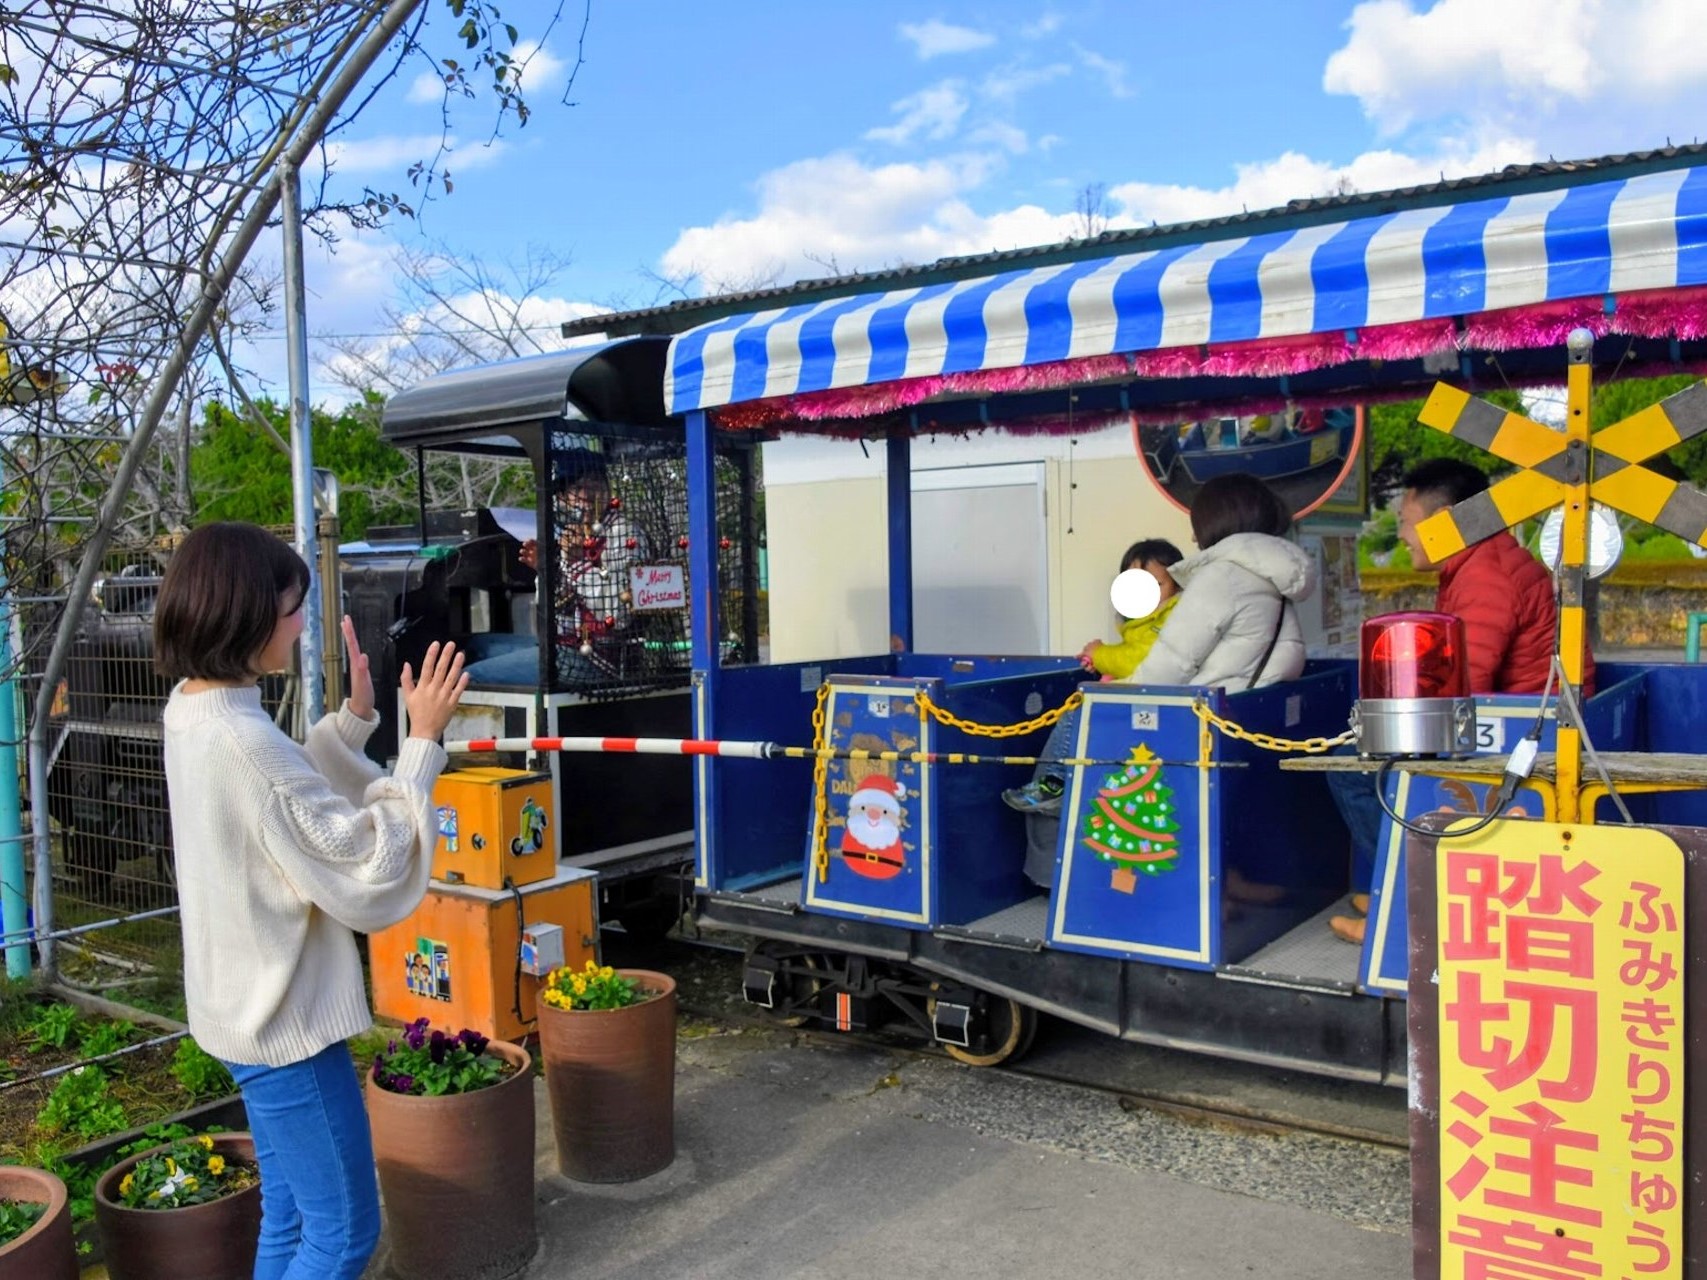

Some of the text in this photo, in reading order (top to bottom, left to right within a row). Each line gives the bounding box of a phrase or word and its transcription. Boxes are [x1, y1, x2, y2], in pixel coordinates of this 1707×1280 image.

[646, 569, 672, 586] Merry
[638, 589, 681, 606] Christmas
[1476, 723, 1495, 748] 3
[1618, 880, 1679, 1280] ふみきりちゅう
